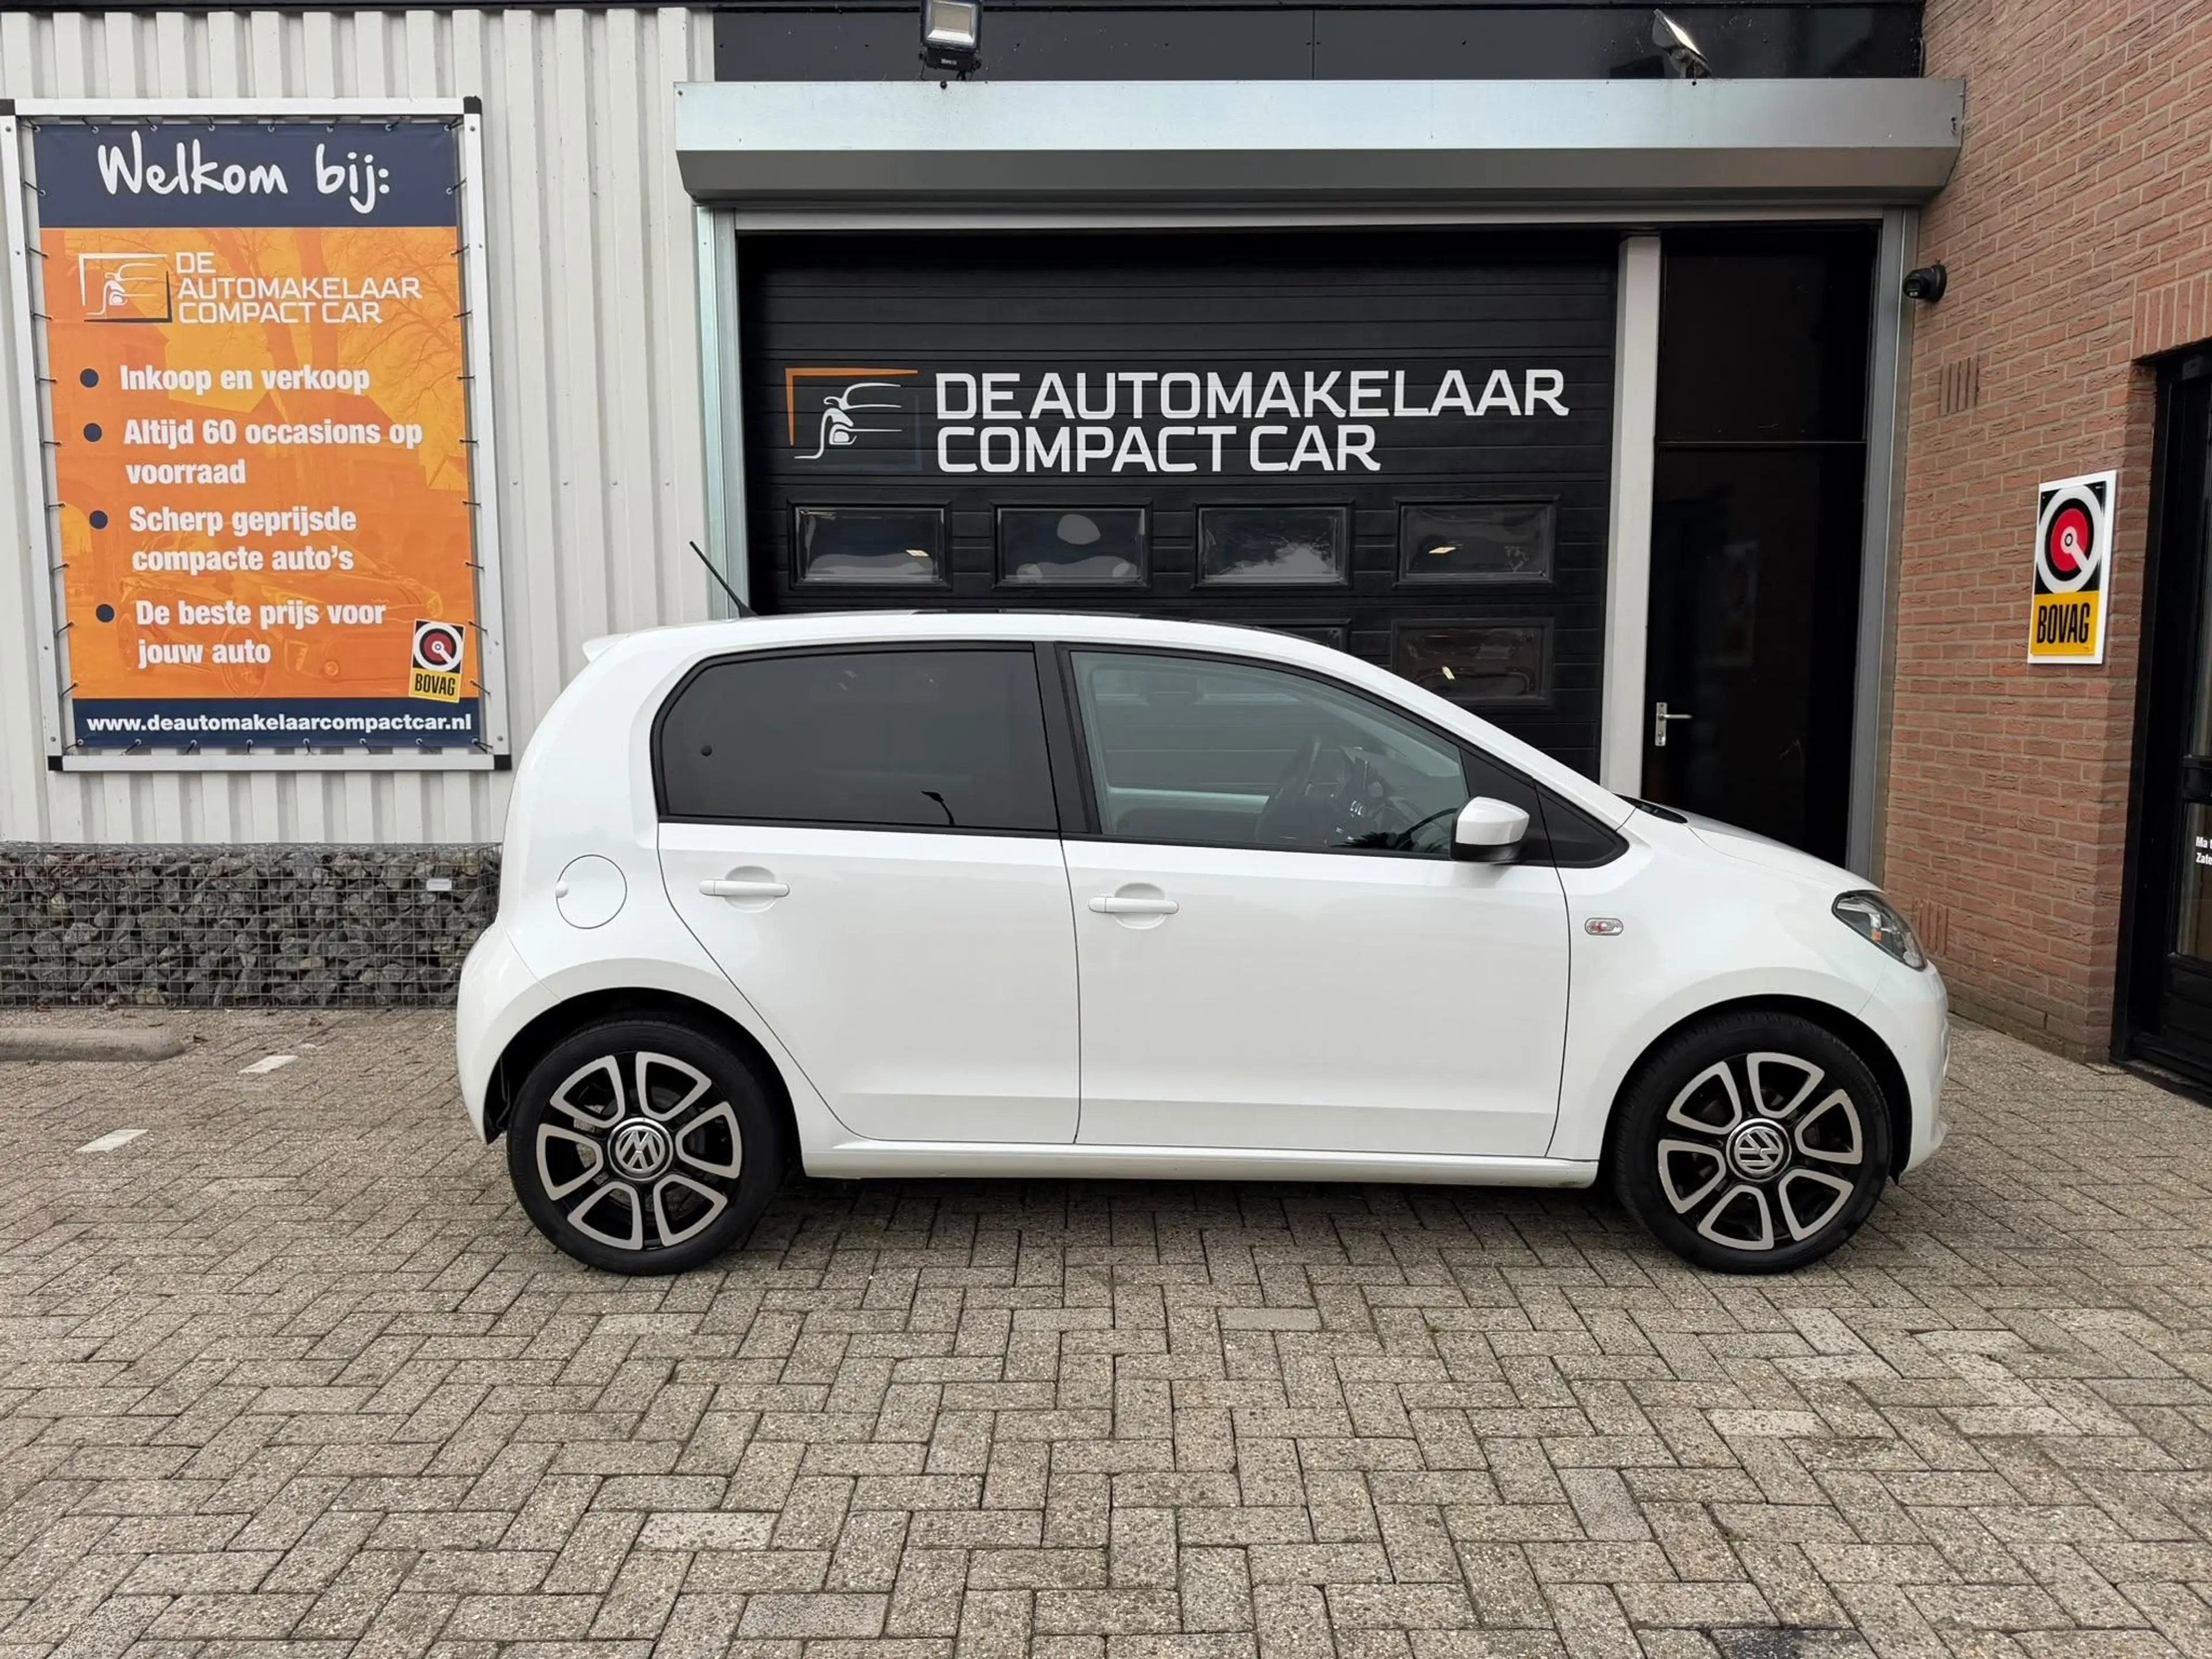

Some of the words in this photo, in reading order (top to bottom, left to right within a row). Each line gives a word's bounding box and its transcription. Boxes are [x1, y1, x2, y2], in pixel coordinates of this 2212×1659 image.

[97, 130, 289, 195] Welkom
[315, 143, 390, 214] bij:
[176, 252, 217, 274] DE
[178, 278, 422, 300] AUTOMAKELAAR
[179, 302, 316, 323] COMPACT
[322, 302, 383, 324] CAR
[120, 365, 211, 395] Inkoop
[220, 369, 252, 389] en
[262, 365, 370, 395] verkoop
[935, 372, 1023, 420] DE
[1029, 369, 1569, 419] AUTOMAKELAAR
[124, 419, 194, 450] Altijd
[202, 419, 237, 444] 60
[245, 419, 381, 444] occasions
[389, 423, 422, 450] op
[937, 425, 1237, 472] COMPACT
[1249, 424, 1381, 472] CAR
[126, 460, 247, 484] voorraad
[129, 507, 223, 537] Scherp
[232, 507, 357, 537] geprijsde
[132, 547, 263, 576] compacte
[136, 601, 170, 625] De
[178, 601, 251, 625] beste
[260, 600, 319, 631] prijs
[327, 605, 386, 625] voor
[2036, 603, 2090, 644] BOVAG
[138, 641, 203, 669] jouw
[212, 641, 271, 665] auto
[414, 673, 456, 696] BOVAG
[86, 714, 472, 732] www.deautomakelaarcompactcar.nl
